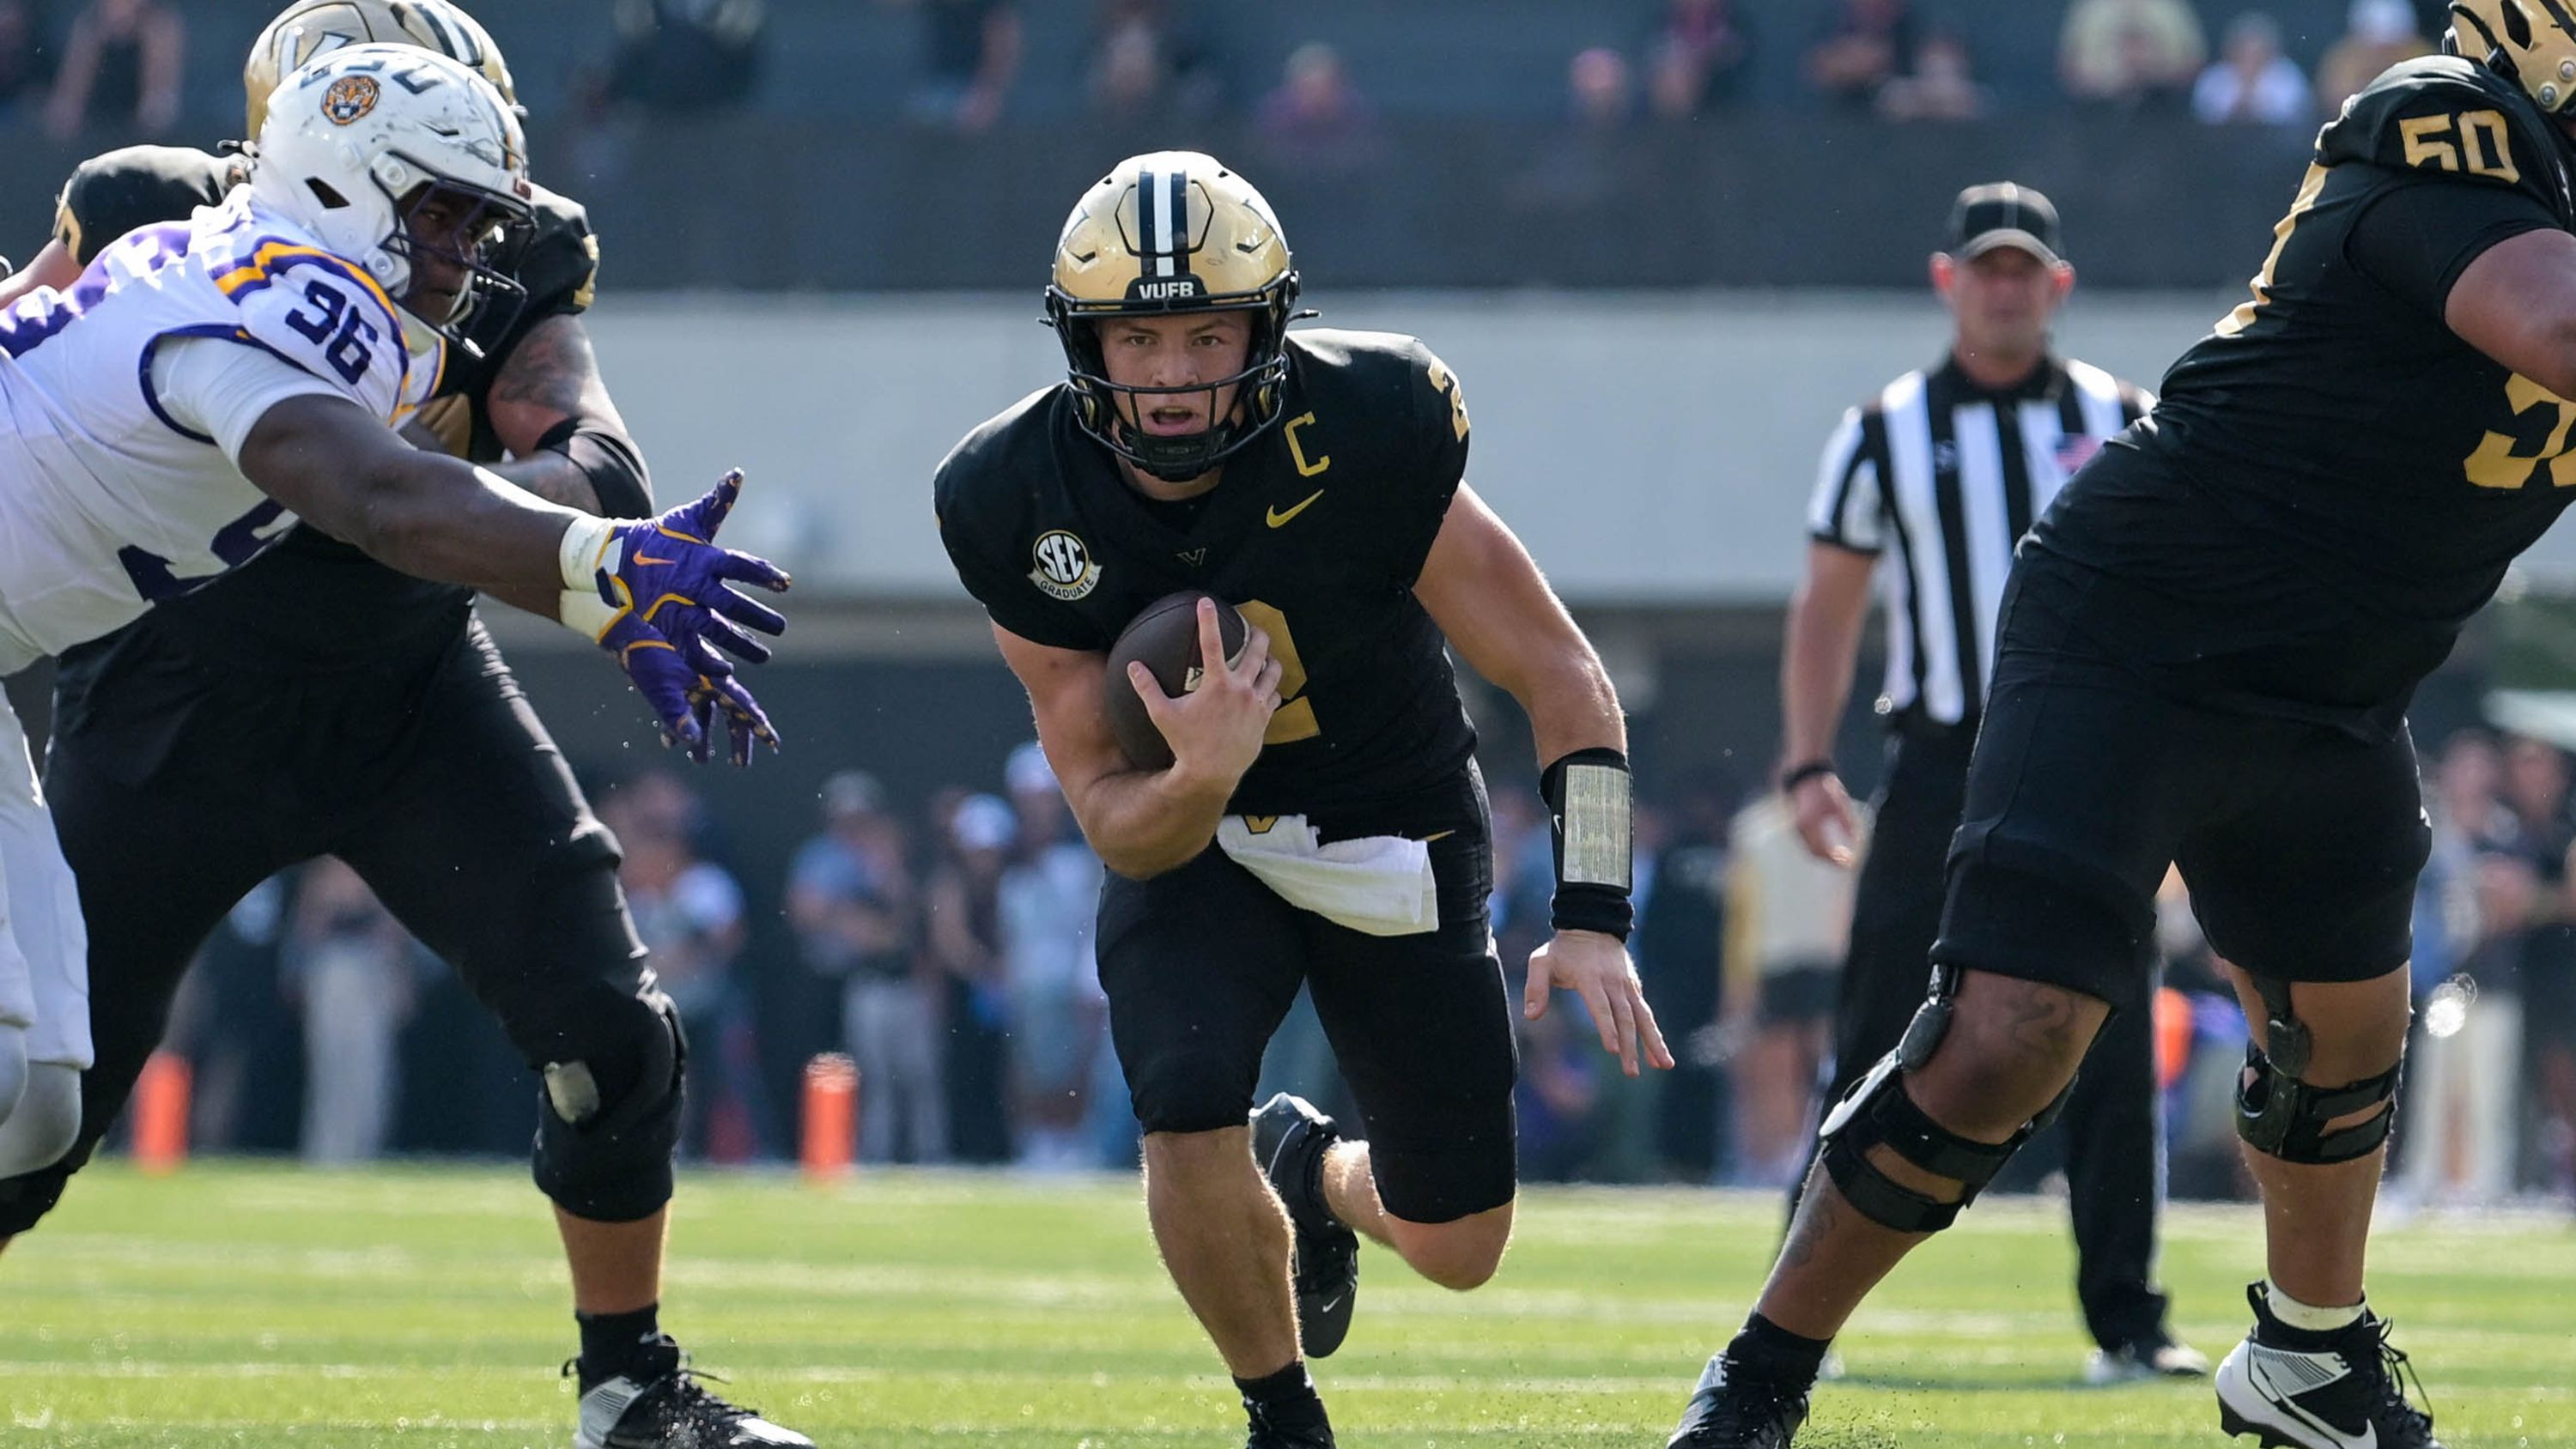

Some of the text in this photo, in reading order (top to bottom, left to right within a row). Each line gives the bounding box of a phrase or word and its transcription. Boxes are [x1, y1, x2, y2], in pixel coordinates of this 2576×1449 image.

[2399, 110, 2520, 184] 50
[1139, 281, 1194, 300] VUFB
[285, 279, 379, 385] 96
[1285, 411, 1330, 477] C
[1037, 534, 1084, 583] SEC
[1040, 577, 1094, 599] GRADUATE
